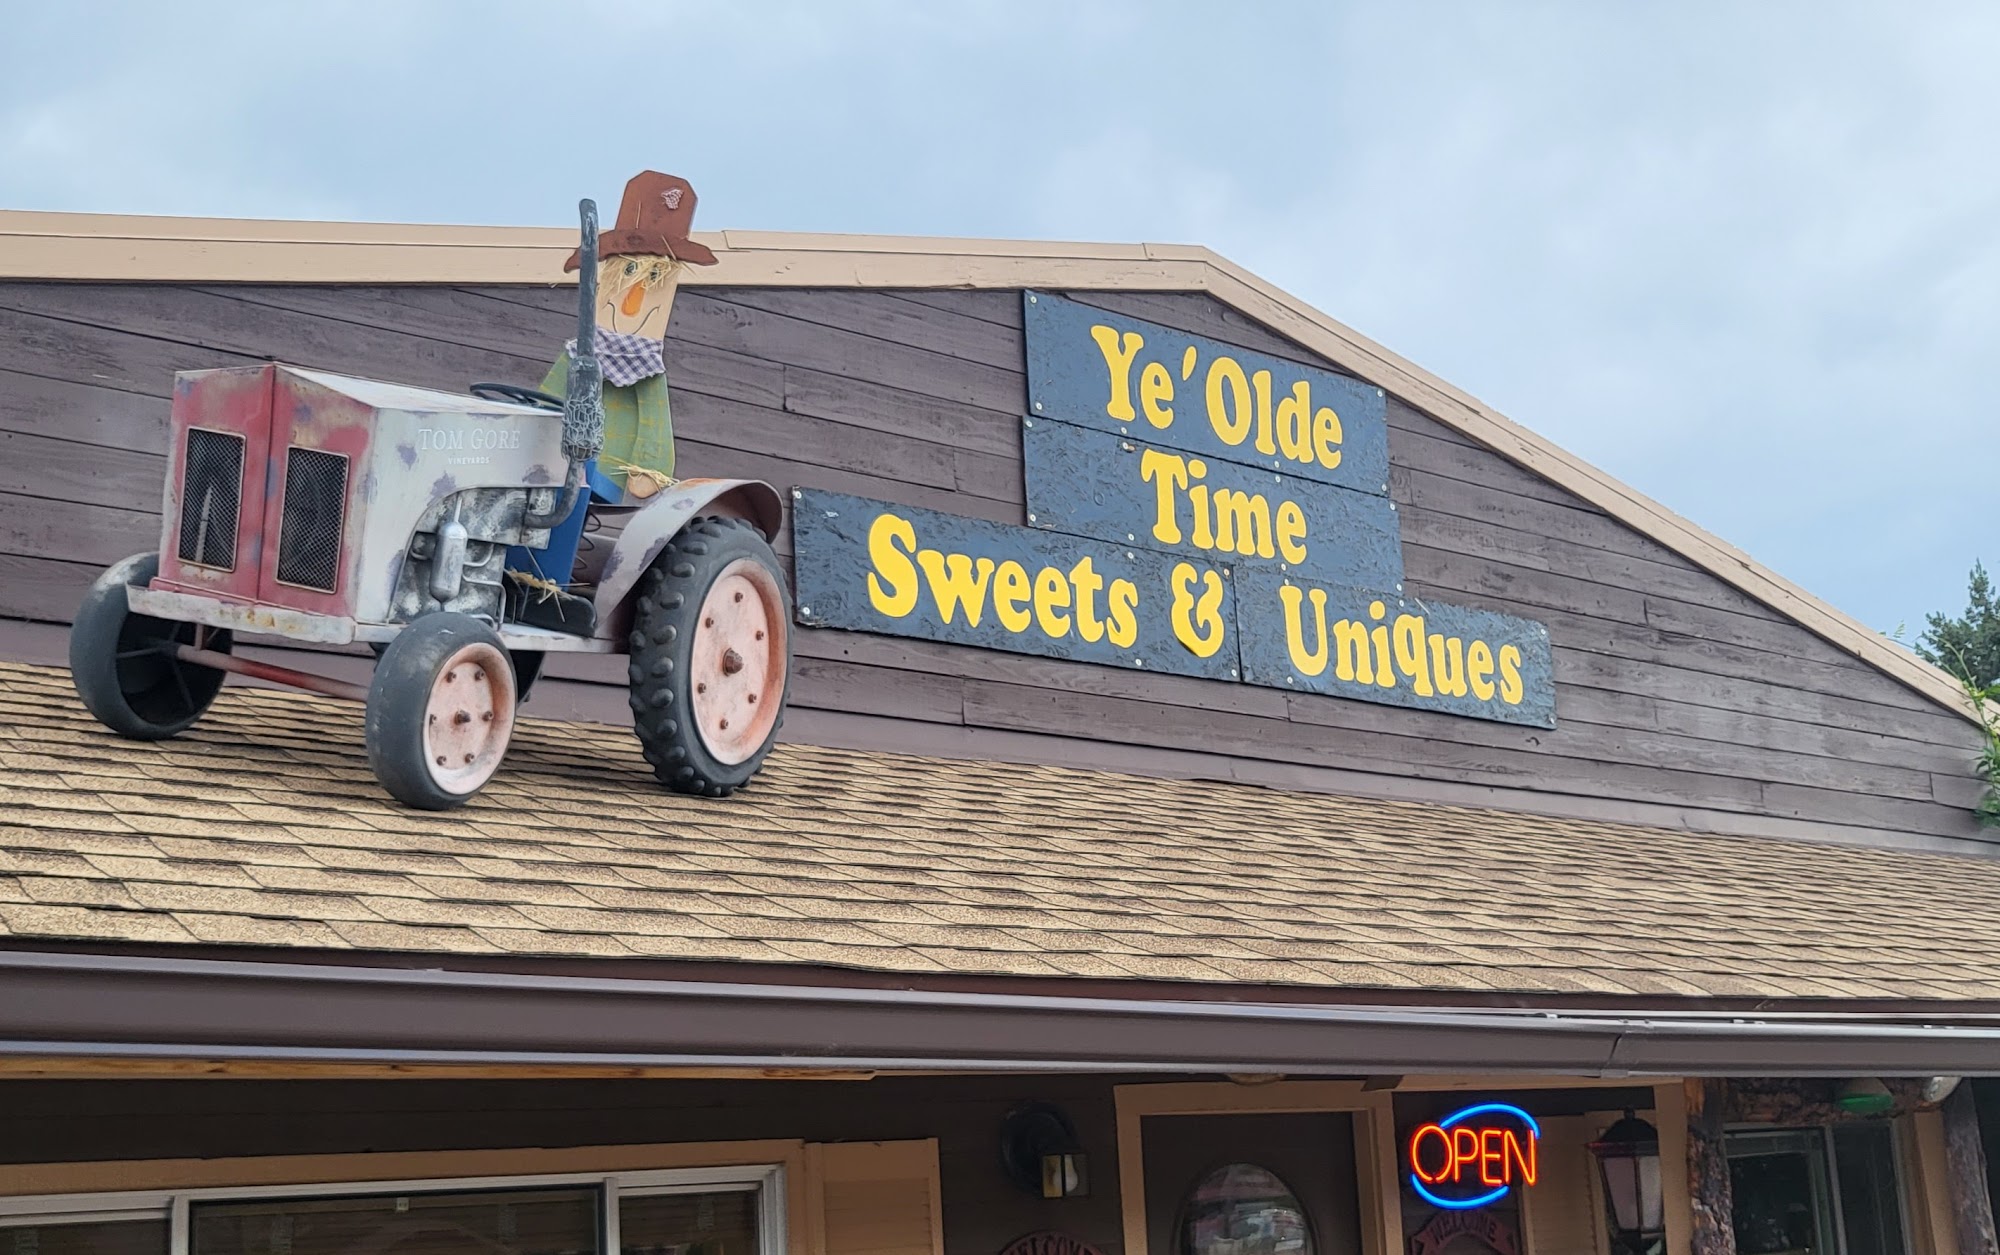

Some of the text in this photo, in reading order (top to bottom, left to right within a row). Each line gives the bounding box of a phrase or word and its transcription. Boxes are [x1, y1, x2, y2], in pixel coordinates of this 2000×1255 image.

[418, 428, 521, 450] TOM GORE
[448, 456, 490, 465] VINEYARDS
[1141, 449, 1307, 565] Time
[867, 513, 1523, 704] Sweets & Uniques
[1409, 1122, 1537, 1187] OPEN
